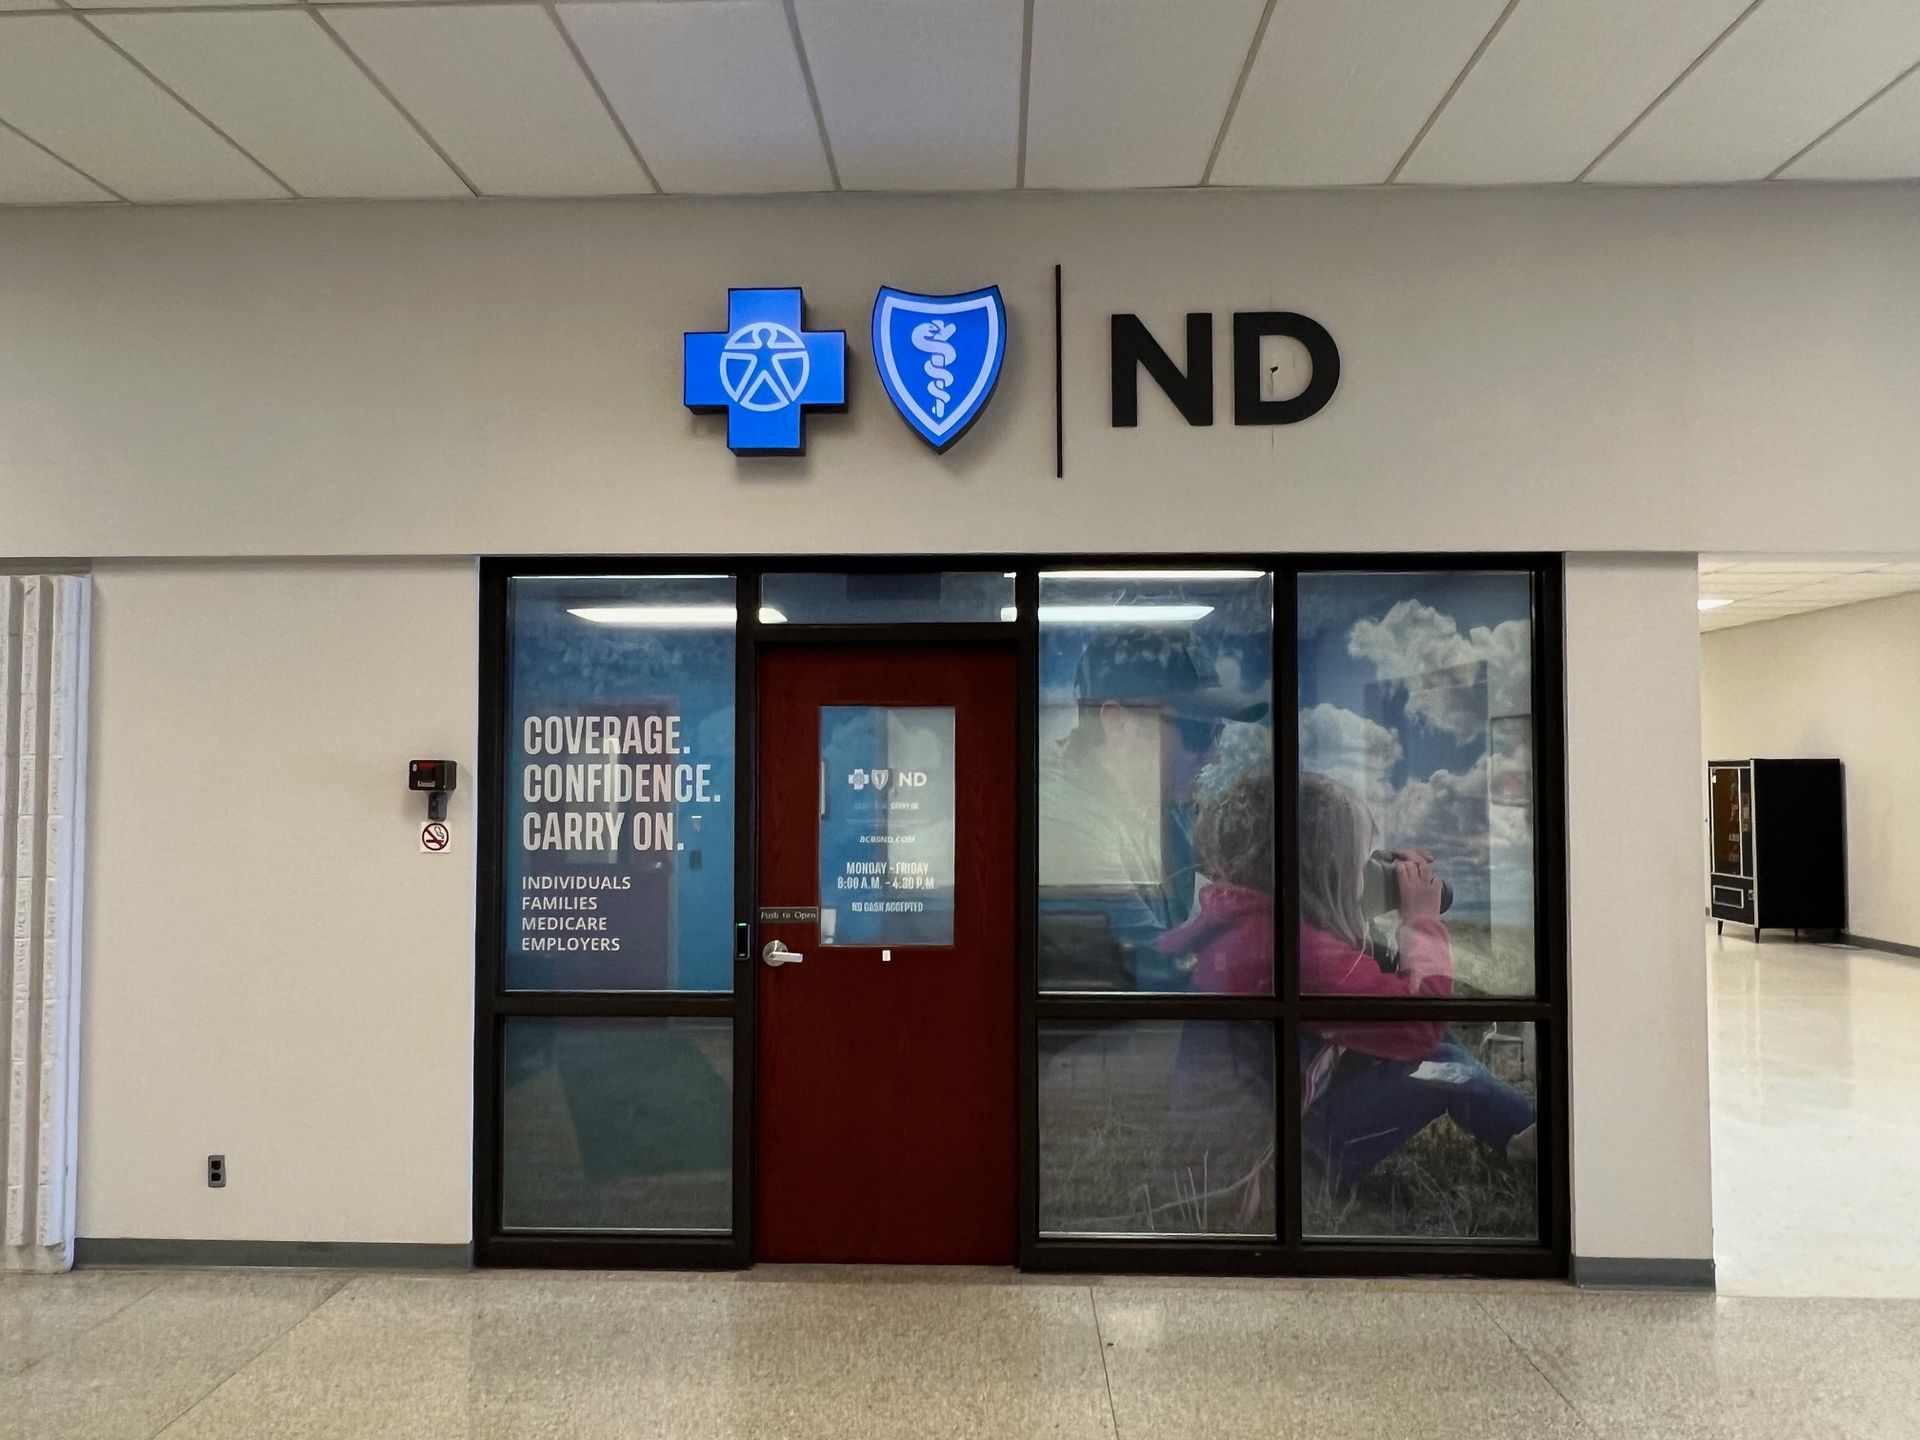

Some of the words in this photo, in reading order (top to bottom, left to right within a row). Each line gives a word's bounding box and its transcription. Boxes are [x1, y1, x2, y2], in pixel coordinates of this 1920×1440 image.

[1111, 312, 1341, 427] ND
[523, 715, 690, 755] COVERAGE.
[523, 764, 721, 803] CONFIDENCE.
[898, 771, 928, 788] ND
[522, 811, 625, 851] CARRY
[633, 811, 684, 851] ON.
[846, 862, 887, 875] MONDAY
[895, 862, 929, 875] FRIDAY
[522, 876, 632, 890] INDIVIDUALS
[837, 876, 859, 889] 8:00
[892, 876, 914, 889] 4:30
[522, 896, 598, 911] FAMILIES
[851, 902, 863, 912] NO
[885, 902, 924, 912] ACCEPTED
[761, 911, 779, 920] Push
[794, 911, 817, 921] Open
[522, 917, 608, 931] MEDICARE
[522, 937, 620, 951] EMPLOYERS
